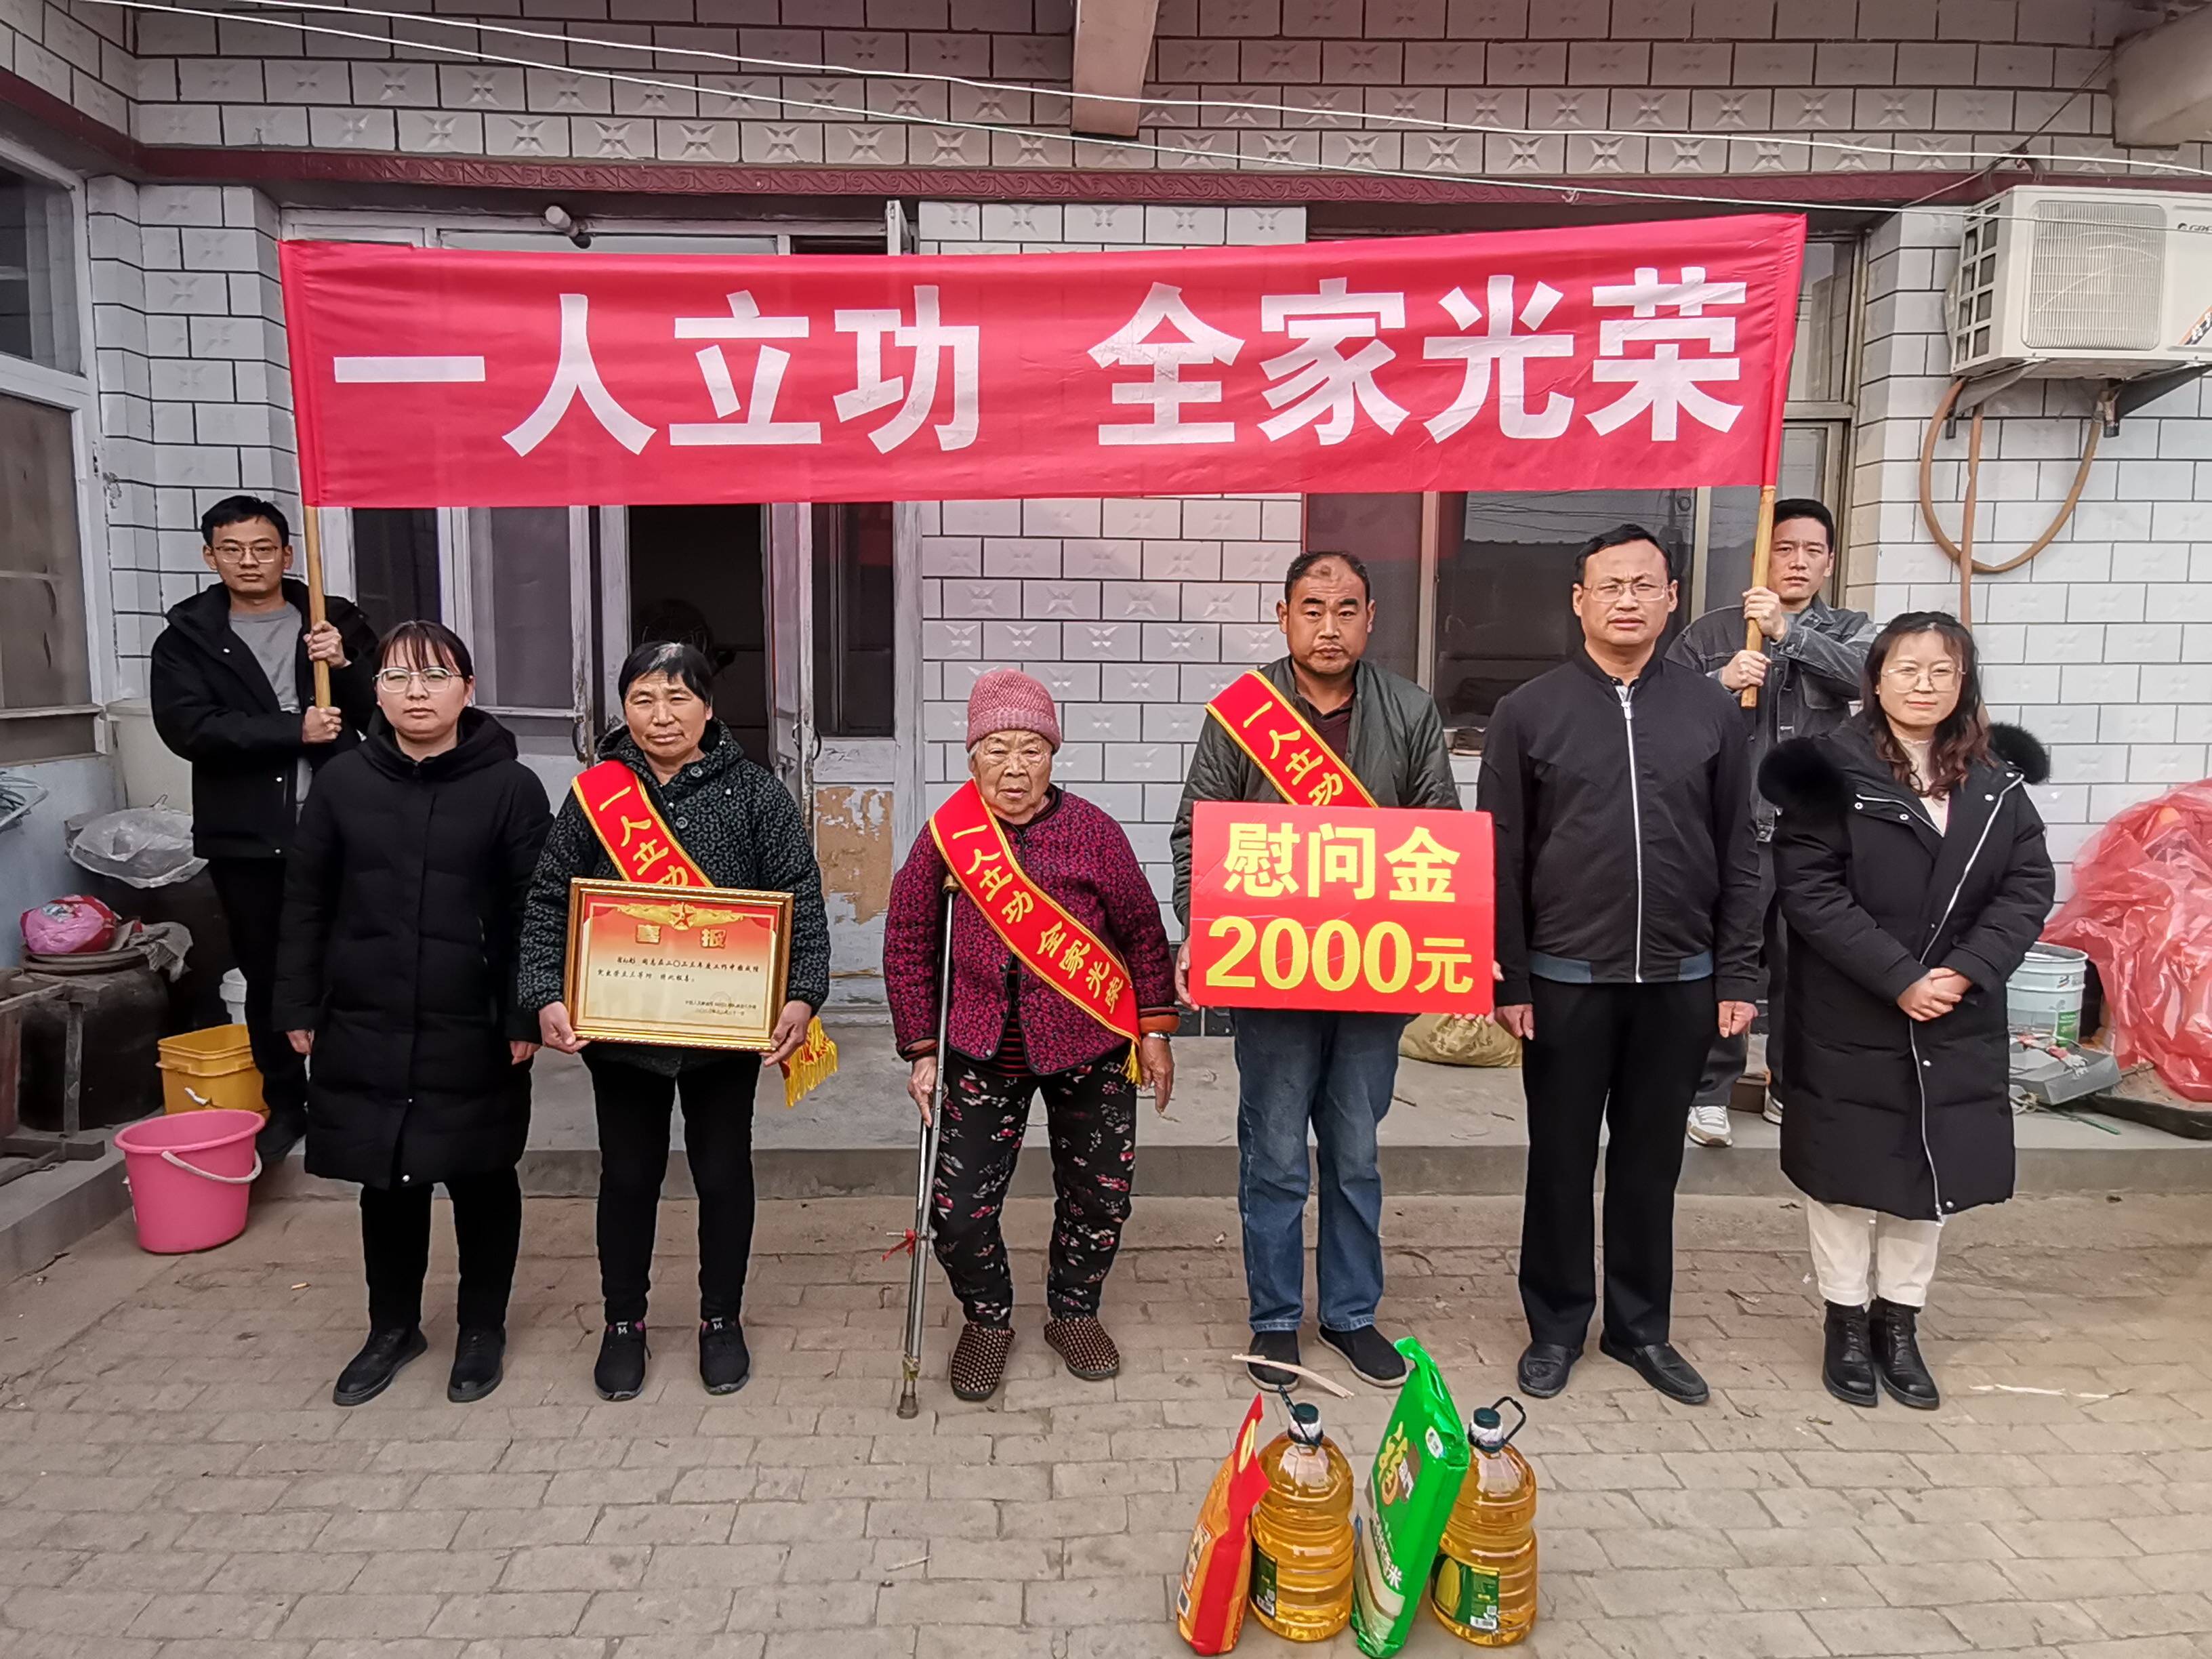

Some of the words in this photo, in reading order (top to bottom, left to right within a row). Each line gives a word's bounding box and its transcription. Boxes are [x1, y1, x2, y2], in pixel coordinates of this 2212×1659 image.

[333, 285, 981, 457] 一人立功
[1087, 266, 1746, 447] 全家光荣
[1243, 701, 1344, 806] 一人立功
[1223, 822, 1460, 903] 慰问金
[951, 824, 1034, 924] 一人立功
[1037, 922, 1124, 1014] 全家光荣
[1205, 915, 1474, 994] 2000元
